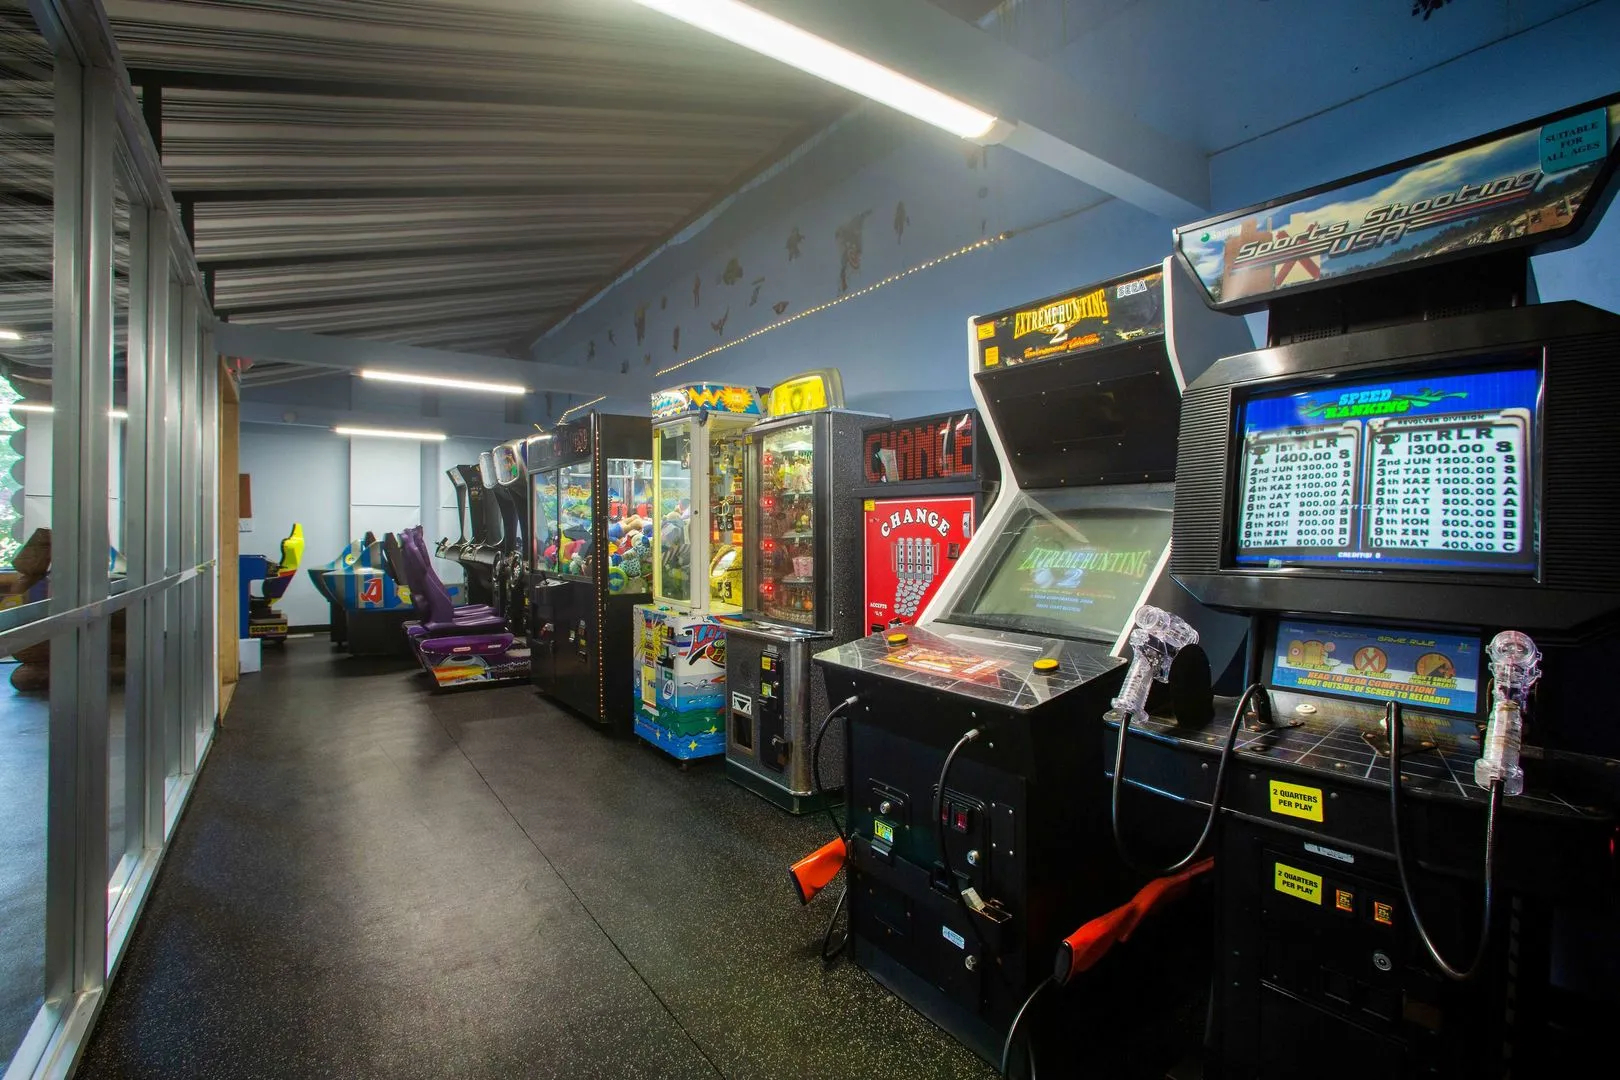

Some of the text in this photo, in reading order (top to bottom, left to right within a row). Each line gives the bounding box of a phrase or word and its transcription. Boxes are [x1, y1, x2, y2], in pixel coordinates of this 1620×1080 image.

[1545, 121, 1598, 143] SUITABLE
[1561, 137, 1582, 148] FOR
[1547, 142, 1600, 161] ALL AGES
[1236, 169, 1543, 260] Sports Shooting
[1328, 221, 1412, 256] USA
[1117, 280, 1147, 298] SEGA
[1014, 288, 1108, 339] EXTREME HUNTING
[1050, 323, 1068, 344] 2
[1339, 389, 1392, 405] SPEED
[1324, 400, 1409, 418] RANKING
[1408, 428, 1494, 442] 1ST RLR
[864, 418, 972, 483] CHANGE
[1408, 441, 1512, 454] 1300.00 S
[1276, 450, 1350, 464] 1400.00 S
[1377, 458, 1400, 467] 2nd
[1436, 456, 1495, 464] 1200.00
[1504, 455, 1515, 463] S
[1436, 466, 1495, 474] 1100.00
[881, 508, 950, 537] CHANGE
[1375, 517, 1397, 525] 8th
[1504, 520, 1516, 528] B
[1375, 528, 1397, 536] 9th
[1442, 530, 1495, 539] 500.00
[1504, 532, 1516, 540] B
[1240, 540, 1262, 548] 10th
[1370, 537, 1396, 547] 10th
[1442, 541, 1494, 550] 400.00
[1057, 568, 1084, 588] 2
[1376, 635, 1436, 647] GAME RULE
[1308, 672, 1330, 680] HEAD
[1344, 677, 1367, 685] HEAD
[1368, 679, 1436, 694] COMPETITION!
[1298, 678, 1322, 686] SHOOT
[1322, 681, 1353, 691] OUTSIDE
[1365, 686, 1395, 697] SCREEN
[1409, 693, 1450, 705] RELOAD!!!
[1280, 790, 1317, 803] QUARTERS
[1279, 799, 1312, 811] PER PLAY
[1282, 880, 1313, 894] PER PLAY
[1284, 872, 1318, 888] QUARTERS
